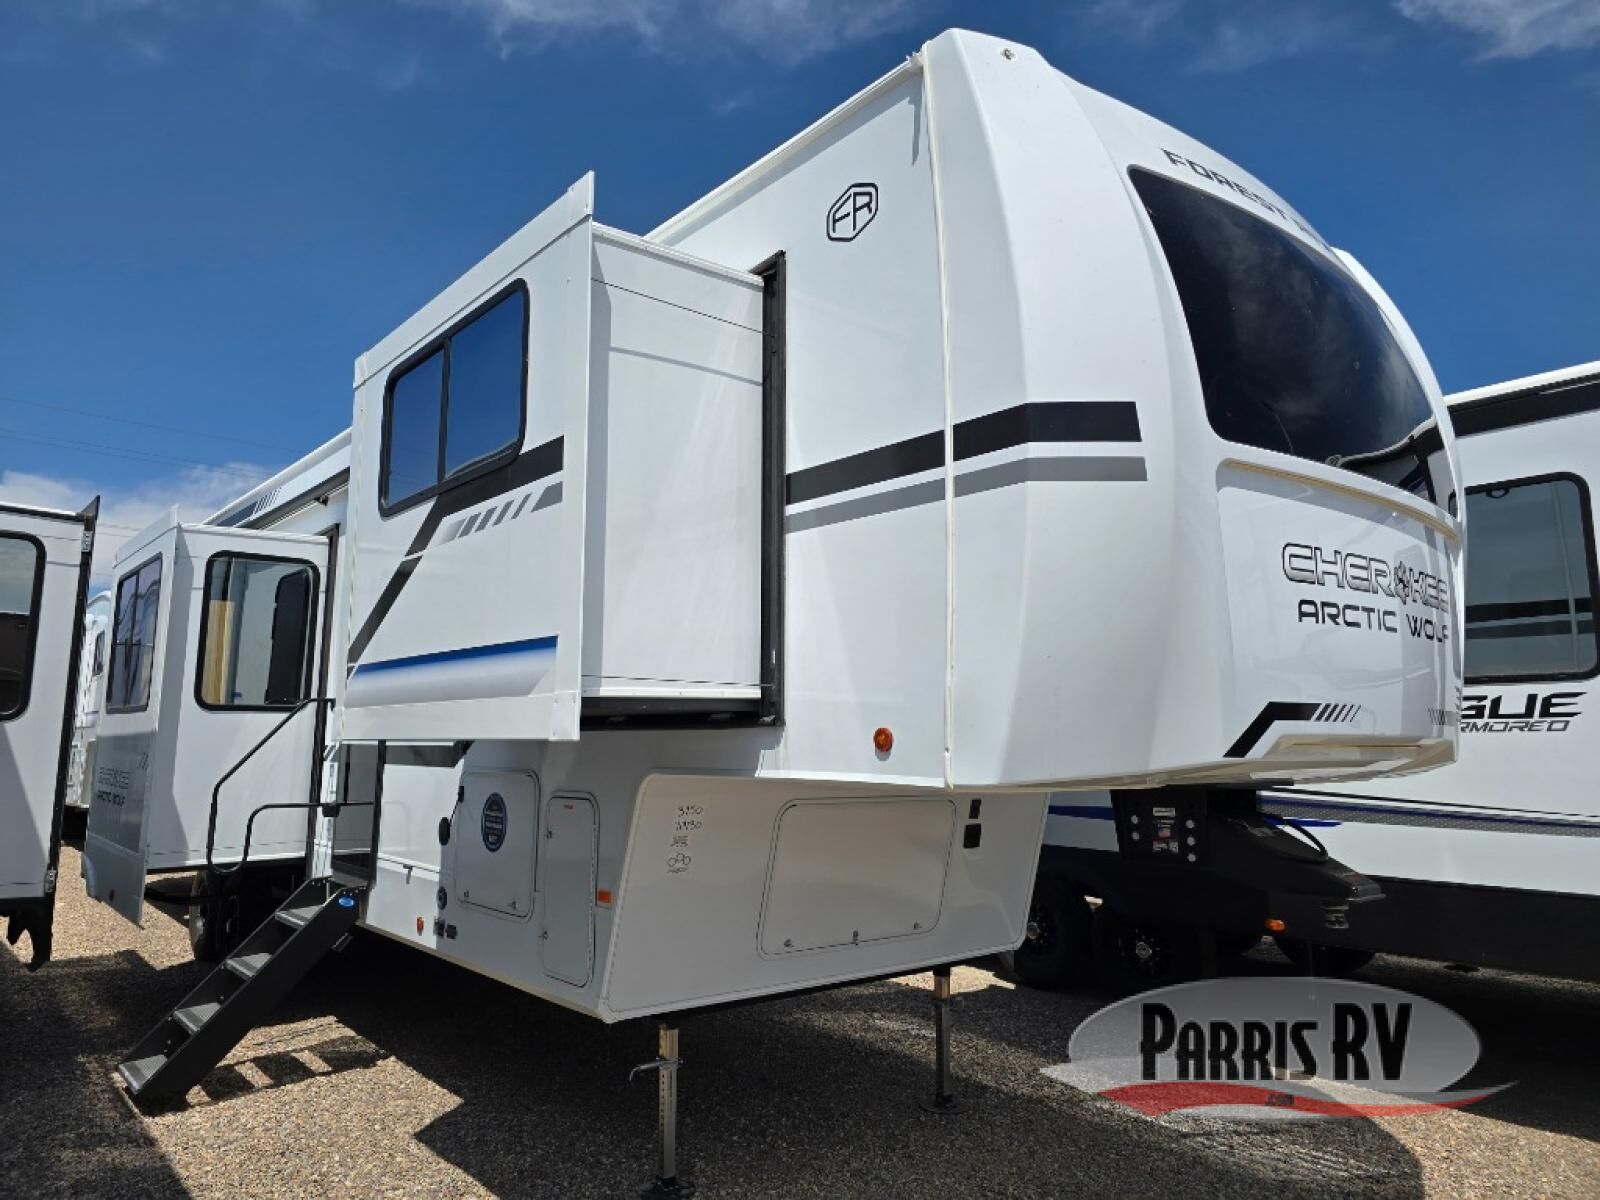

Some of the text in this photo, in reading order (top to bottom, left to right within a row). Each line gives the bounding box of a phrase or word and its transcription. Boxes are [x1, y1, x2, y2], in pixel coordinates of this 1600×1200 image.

[1161, 147, 1288, 220] FOREST
[1282, 541, 1449, 613] CHEROKEE
[1297, 598, 1449, 643] ARCTIC WOLF
